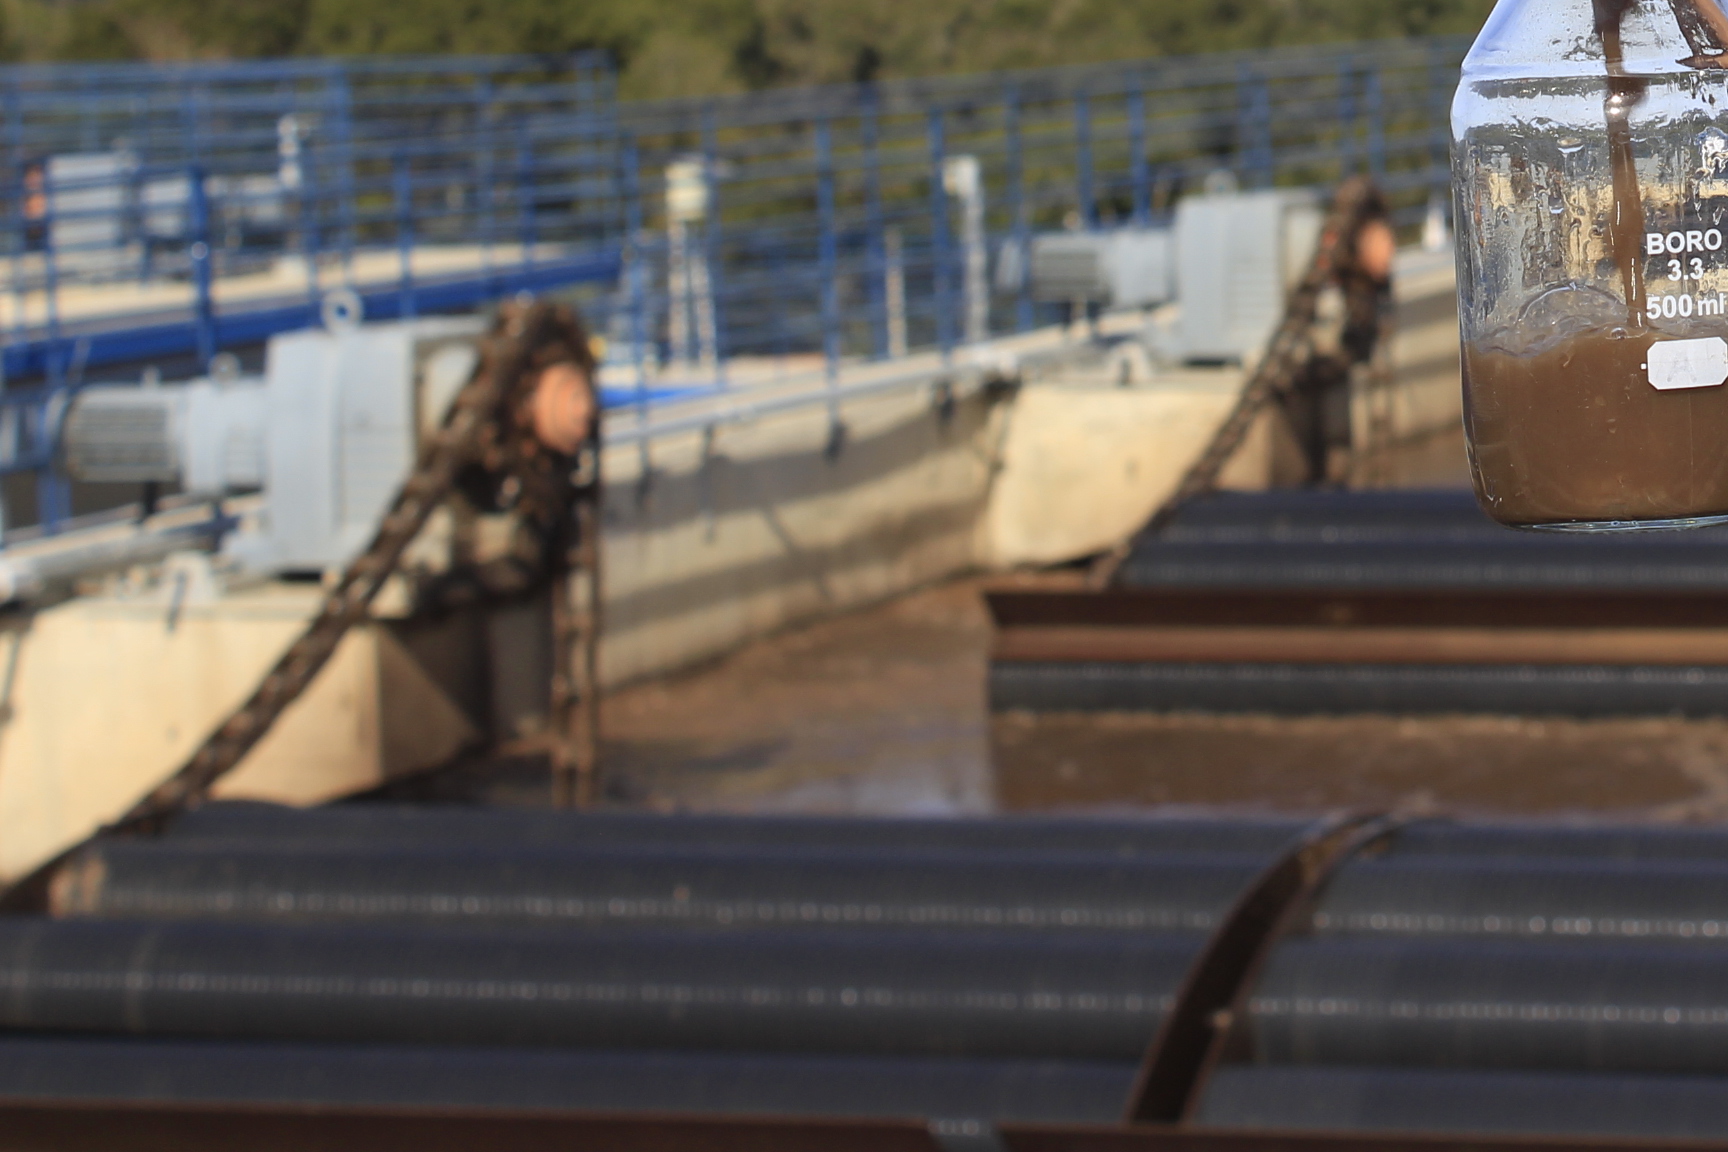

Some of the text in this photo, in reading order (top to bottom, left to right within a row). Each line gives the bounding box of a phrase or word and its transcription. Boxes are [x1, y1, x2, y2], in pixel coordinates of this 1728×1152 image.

[1646, 228, 1722, 255] BORO
[1667, 257, 1704, 281] 3.3
[1646, 293, 1725, 319] 500 ml
